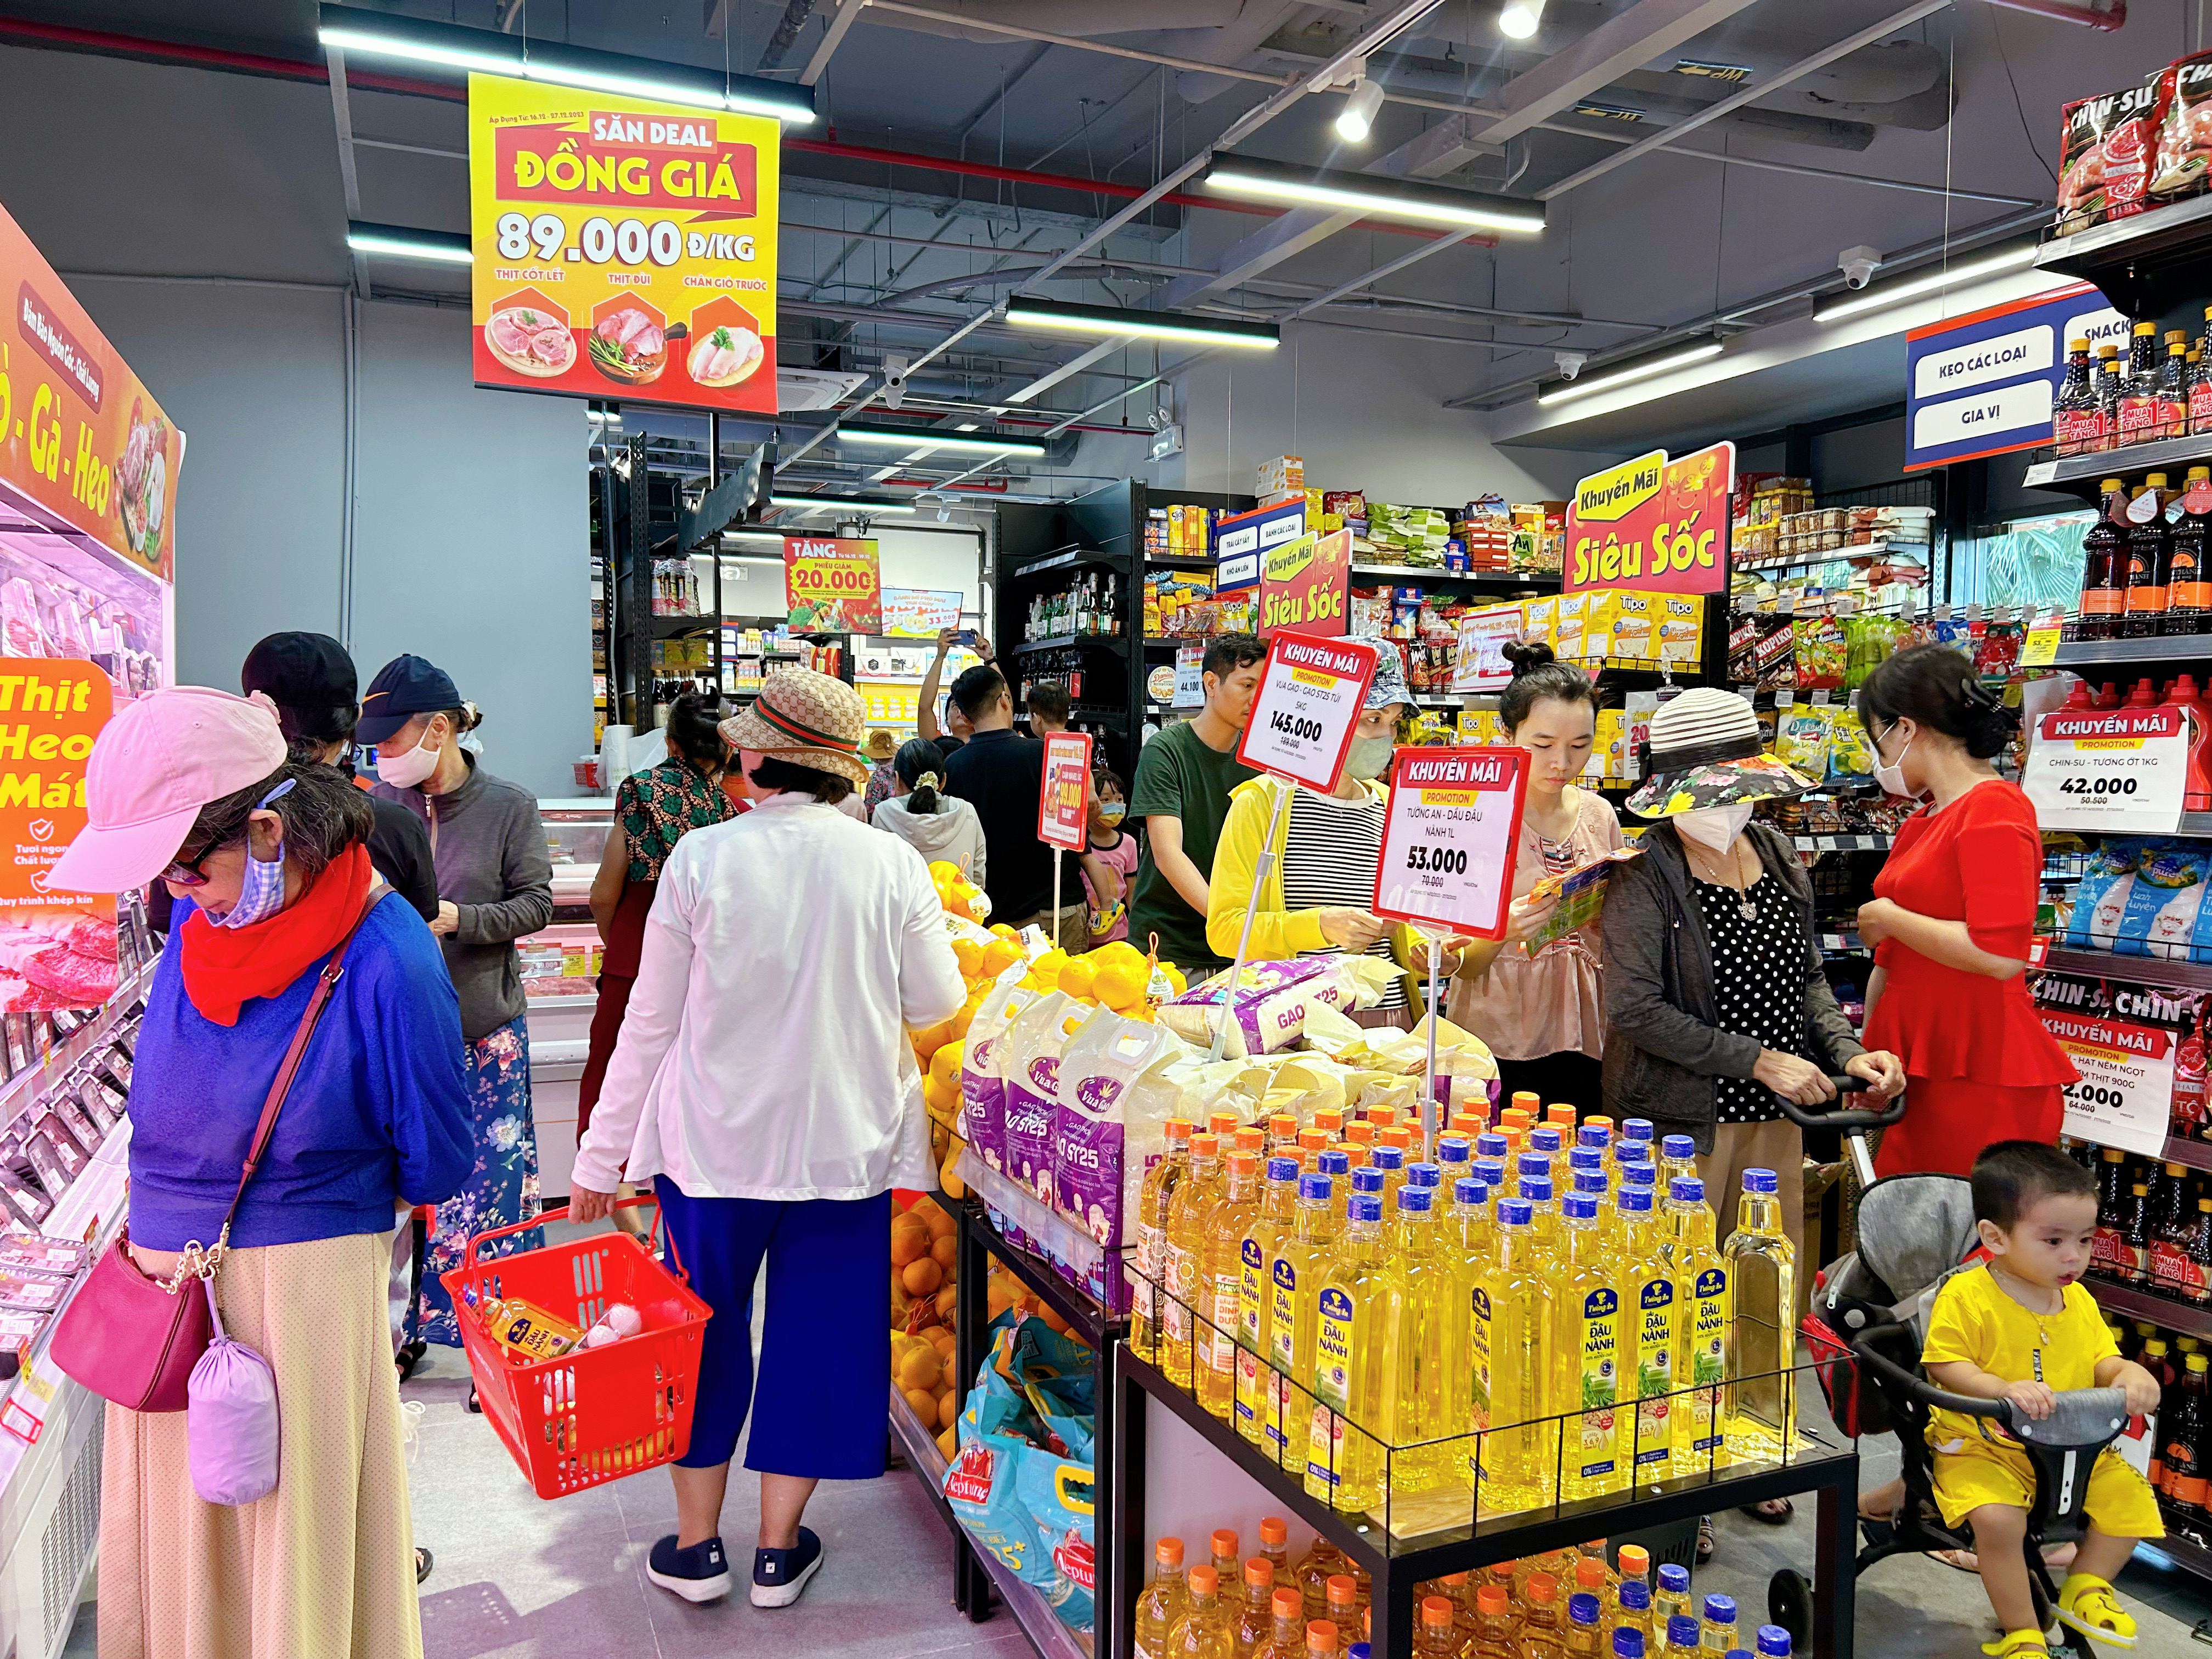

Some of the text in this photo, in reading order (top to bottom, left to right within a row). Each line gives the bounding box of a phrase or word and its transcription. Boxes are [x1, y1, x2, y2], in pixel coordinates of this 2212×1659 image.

[489, 115, 499, 124] Áp
[594, 116, 712, 147] SĂN DEAL
[514, 138, 741, 200] ĐỒNG GIÁ
[497, 213, 755, 266] 89.000 Đ/KG
[496, 267, 566, 281] THỊT CỐT LẾT
[608, 272, 652, 286] THỊT ĐÙI
[684, 274, 768, 291] CHÂN GIÒ TRƯỚC
[24, 297, 37, 332] Đảm
[37, 312, 48, 343] Bảo
[47, 325, 64, 362] Nguồn
[64, 345, 75, 373] Gốc
[1939, 345, 2027, 379] KẸO CÁC LOẠI
[1961, 403, 2000, 424] GIA VỊ
[2125, 406, 2148, 420] MUA
[2070, 419, 2094, 431] MUA
[30, 382, 110, 518] Gà Heo
[1580, 466, 1658, 511] Khuyến Mãi
[1277, 524, 1285, 535] CÁC
[792, 539, 836, 560] TẶNG
[1511, 534, 1529, 552] An
[1573, 509, 1715, 586] Siêu Sốc
[1269, 543, 1312, 574] Khuyến Mãi
[1222, 601, 1243, 613] Tipo
[1263, 575, 1342, 629] Siêu Sốc
[1527, 602, 1547, 619] Tipo
[1560, 599, 1580, 615] Tipo
[1620, 595, 1647, 612] Tipo
[1666, 599, 1694, 616] Tipo
[1756, 625, 1793, 658] KOPIKO
[1284, 643, 1360, 675] KHUYẾN MÃI
[1180, 681, 1199, 692] 44.100
[1295, 671, 1331, 686] PROMOTION
[0, 675, 92, 720] Thịt
[1276, 680, 1341, 703] VUA GẠO GẠO ST25 TÚI
[1295, 701, 1307, 711] 5KG
[1270, 710, 1322, 742] 145.000
[1462, 716, 1479, 730] Tipo
[2055, 714, 2168, 735] KHUYẾN MÃI
[0, 724, 95, 761] Heo
[1408, 757, 1502, 783] KHUYẾN MÃI
[2049, 758, 2086, 767] CHIN-SU
[2094, 757, 2125, 766] TƯƠNG
[2126, 755, 2140, 766] ỚT
[0, 771, 88, 809] Mát
[2060, 777, 2137, 794] 42.000
[1059, 781, 1082, 809] 99.000
[1426, 792, 1470, 804] PROMOTION
[1407, 806, 1482, 825] TƯỜNG AN DẦU ĐẬU
[1425, 825, 1454, 838] NÀNH 1L
[14, 854, 38, 865] Chất
[1406, 845, 1468, 875] 53.000
[19, 894, 93, 906] trình khép kín
[1277, 1004, 1305, 1030] GẠO
[2041, 1018, 2153, 1052] KHUYẾN MÃI
[2068, 1044, 2120, 1061] PROMOTION
[2078, 1057, 2146, 1079] HẠT NÊM NGỌT
[1034, 1070, 1051, 1089] Vua
[2091, 1073, 2135, 1090] THỊT 900G
[1081, 1090, 1098, 1108] Vua
[2069, 1101, 2095, 1113] 64.000
[1068, 1142, 1099, 1169] ST25
[2156, 1254, 2179, 1269] MUA
[1244, 1272, 1258, 1289] ĐẬU
[1241, 1283, 1259, 1304] NÀNH
[1277, 1294, 1291, 1311] ĐẬU
[1273, 1306, 1293, 1327] NÀNH
[1700, 1302, 1720, 1317] ĐẬU
[1646, 1313, 1667, 1328] ĐẬU
[1696, 1316, 1723, 1331] NÀNH
[1323, 1323, 1345, 1342] ĐẬU
[1475, 1322, 1488, 1342] ĐẬU
[1589, 1323, 1611, 1339] ĐẬU
[1641, 1328, 1669, 1342] NÀNH
[1318, 1337, 1348, 1359] NÀNH
[1472, 1335, 1490, 1358] NÀNH
[1585, 1337, 1615, 1353] NÀNH
[1638, 1455, 1647, 1463] 0%
[1583, 1465, 1592, 1476] 0%
[947, 1472, 989, 1503] Neptune
